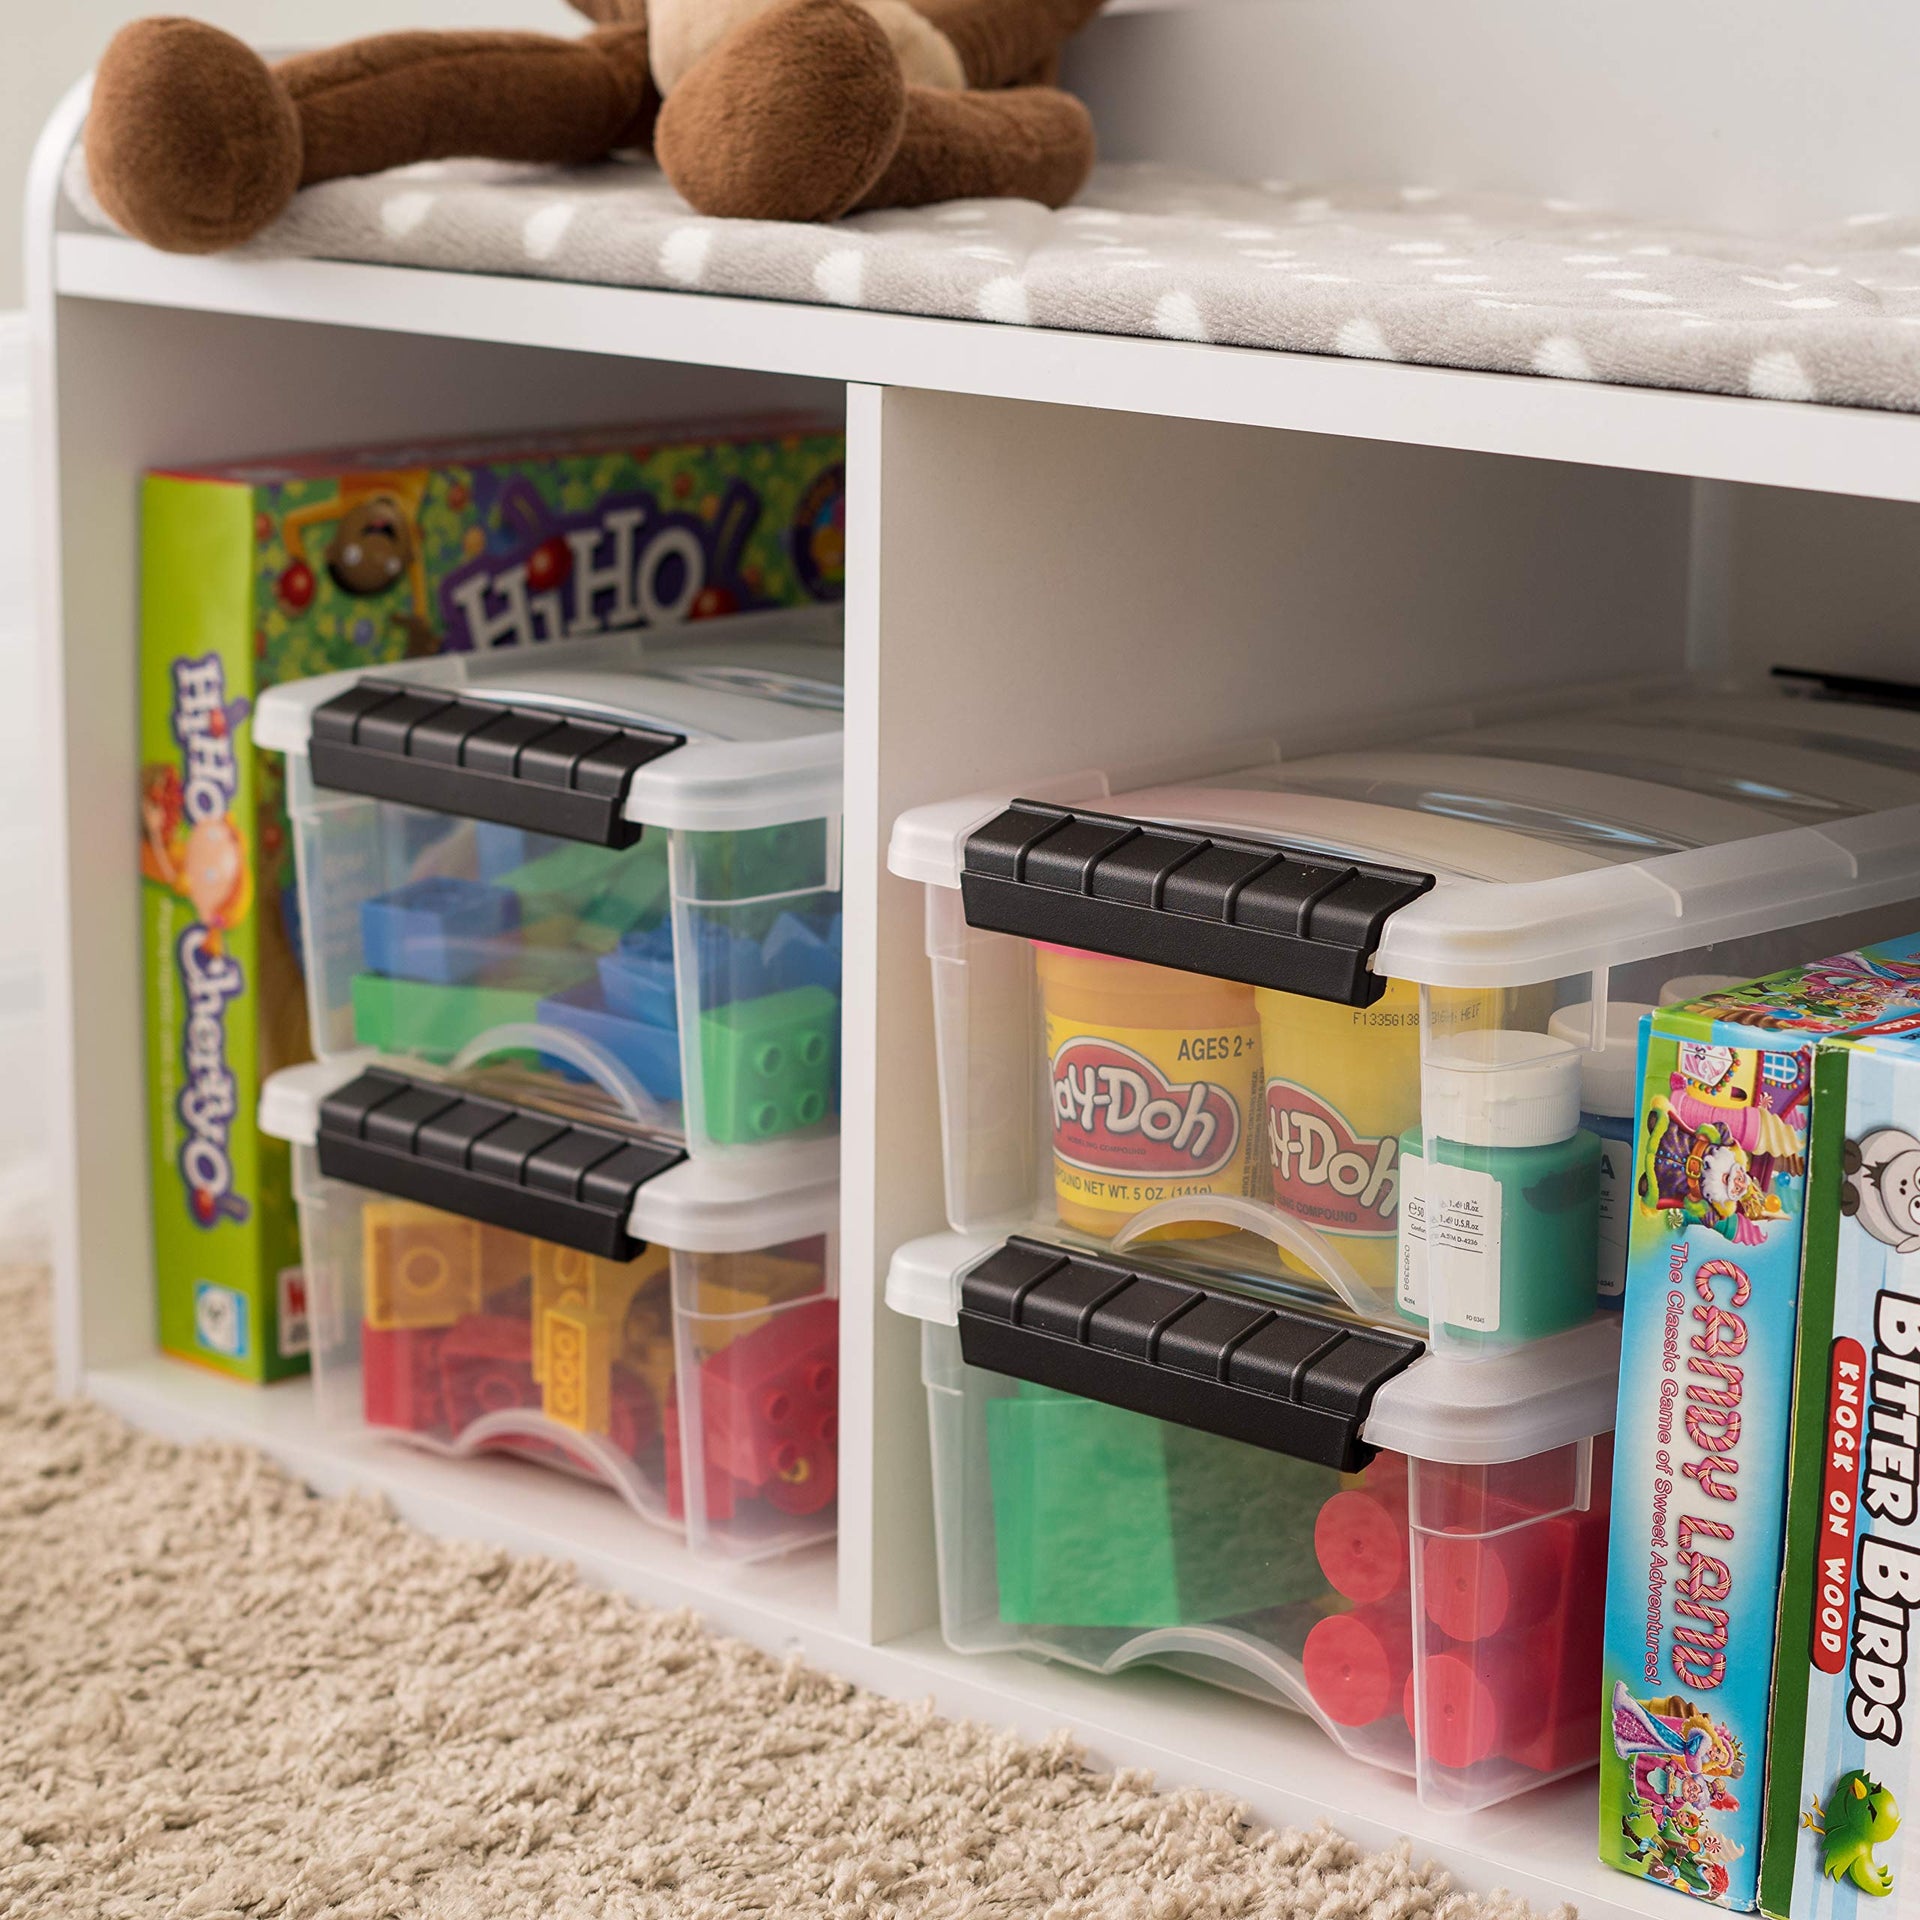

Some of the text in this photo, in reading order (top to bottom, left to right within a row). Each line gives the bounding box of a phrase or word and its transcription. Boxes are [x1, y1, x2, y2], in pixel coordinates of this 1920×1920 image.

[1177, 1035, 1230, 1061] AGES
[1084, 1179, 1105, 1198] NET
[1108, 1184, 1130, 1200] WT.
[1133, 1187, 1141, 1201] 5
[1144, 1187, 1167, 1201] OZ.
[1295, 1201, 1358, 1223] COMPOUND
[1643, 1241, 1690, 1687] The Classic Game of Sweet Adventures!
[1820, 1360, 1860, 1654] KNOCK ON WOOD
[1849, 1292, 1920, 1744] BITTER BIRDS
